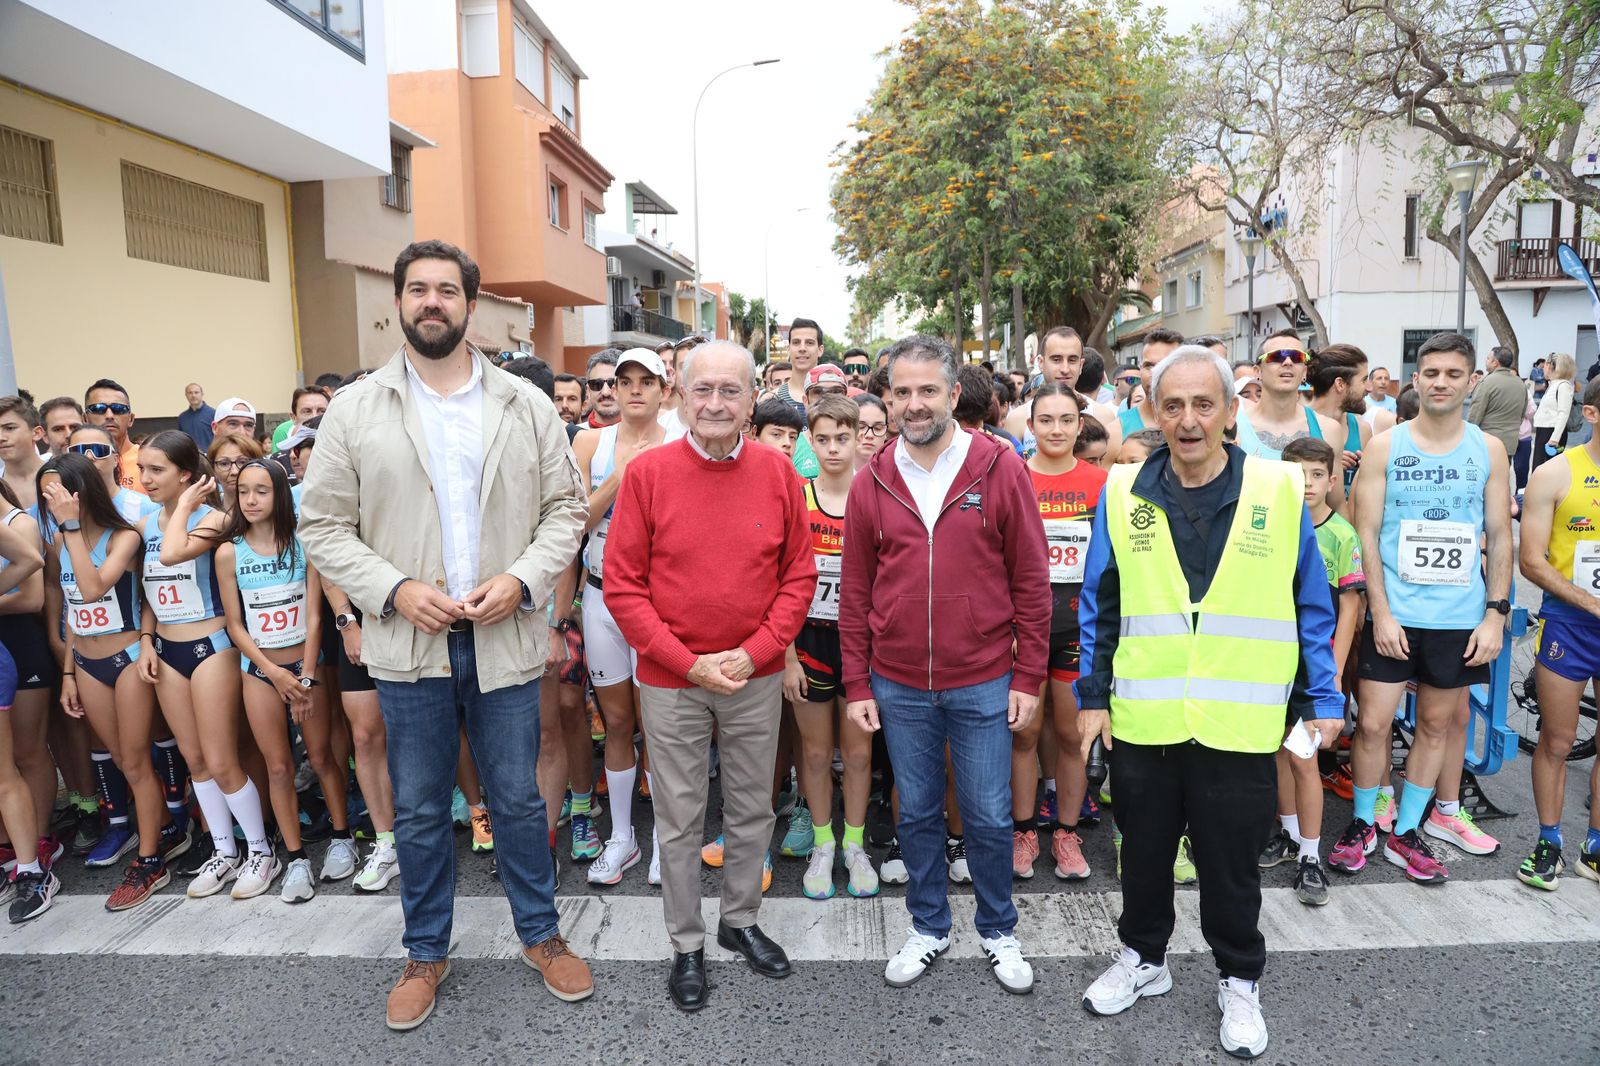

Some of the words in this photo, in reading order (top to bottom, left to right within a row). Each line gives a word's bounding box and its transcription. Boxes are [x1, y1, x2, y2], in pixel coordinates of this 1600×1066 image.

[1396, 456, 1420, 466] TROPS
[1395, 465, 1460, 485] nerja
[1038, 490, 1086, 504] álaga
[1039, 502, 1087, 513] Bahía
[1423, 509, 1450, 519] TROPS
[810, 523, 841, 536] Mála
[1566, 525, 1595, 533] Vopak
[1414, 547, 1462, 569] 528
[239, 560, 289, 575] nerja
[158, 584, 183, 606] 61
[258, 606, 299, 633] 297
